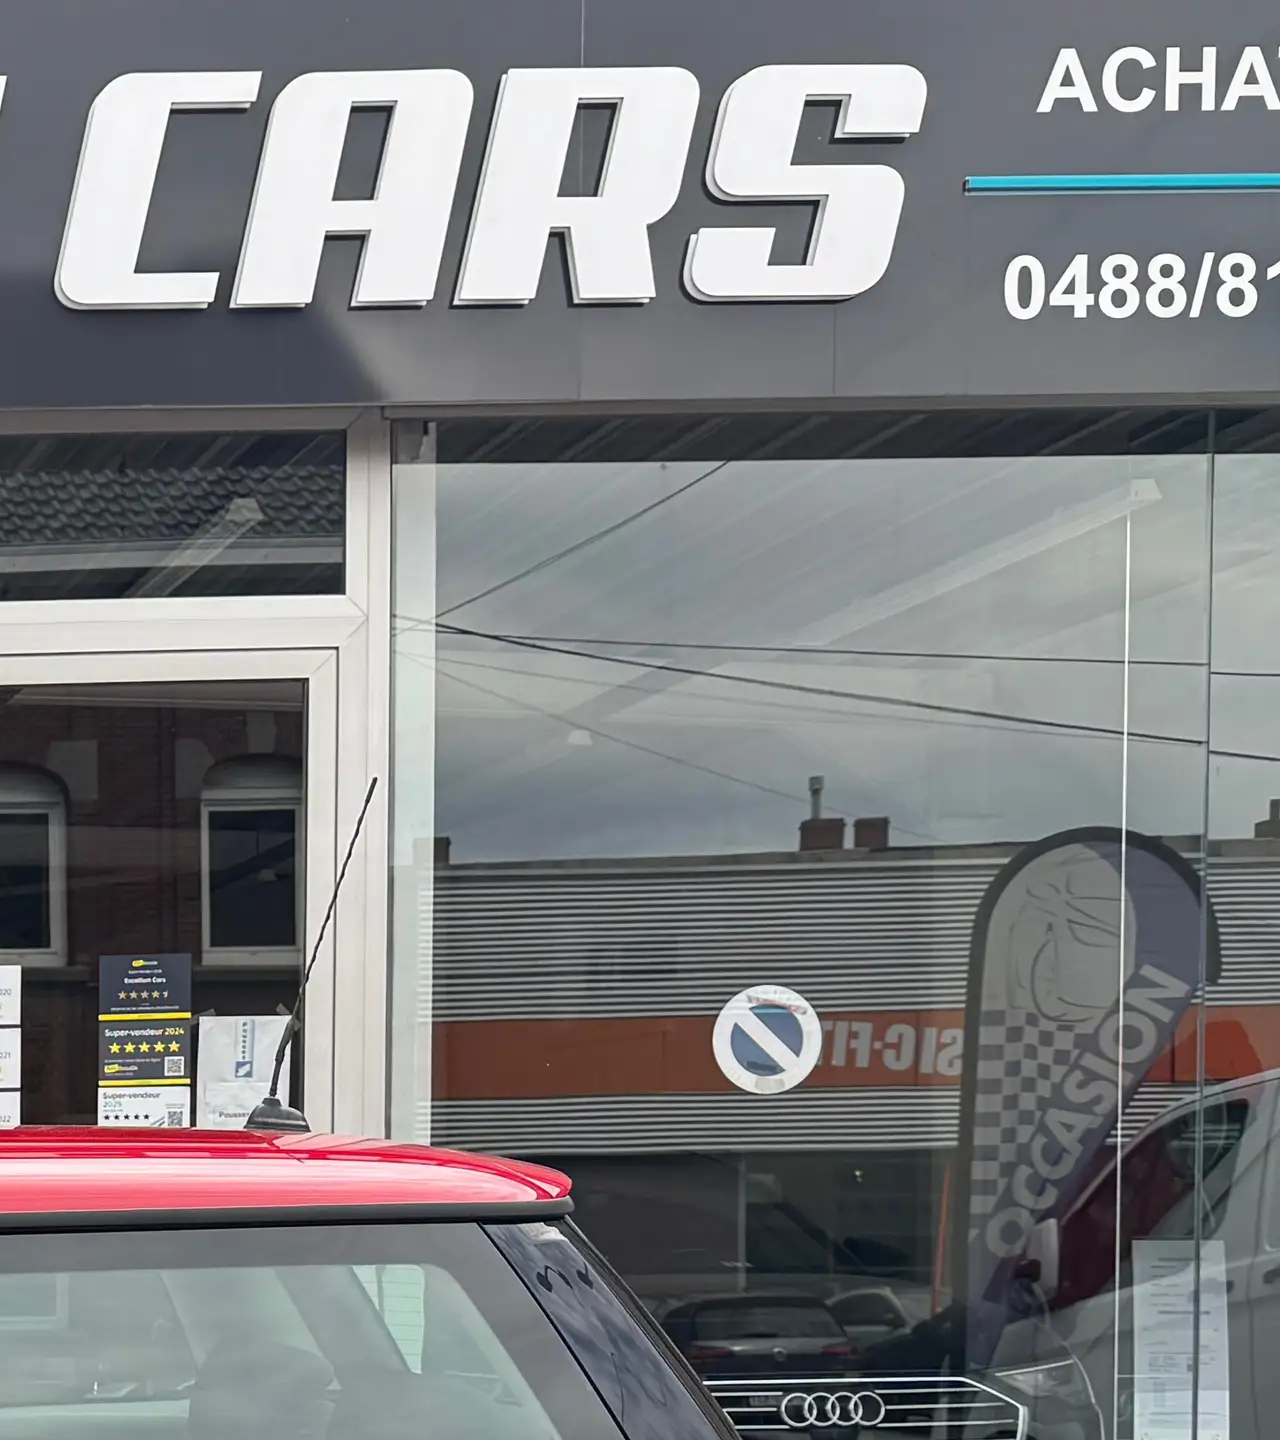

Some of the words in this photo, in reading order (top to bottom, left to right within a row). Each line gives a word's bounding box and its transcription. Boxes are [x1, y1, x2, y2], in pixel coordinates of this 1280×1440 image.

[53, 64, 928, 310] CARS
[1036, 46, 1280, 113] ACHA
[986, 964, 1192, 1258] OCCASION
